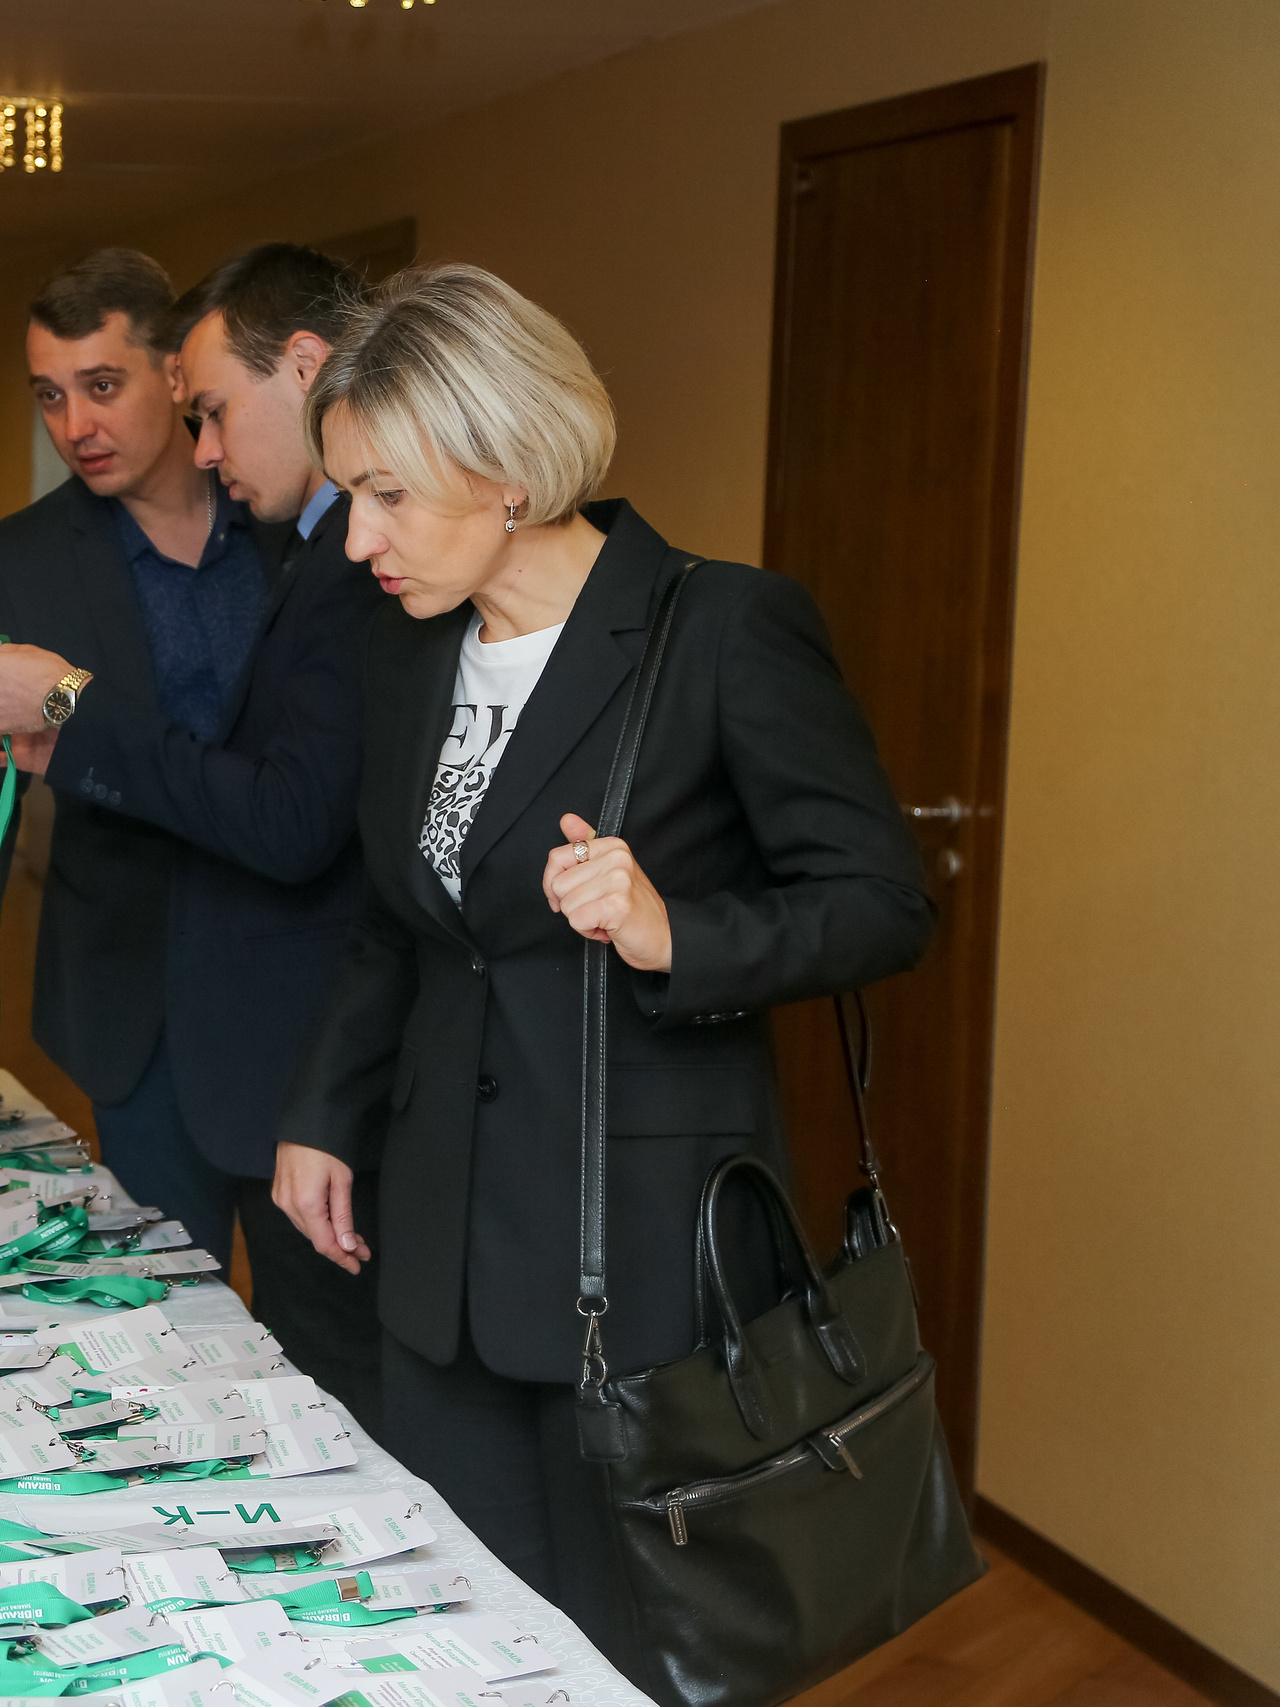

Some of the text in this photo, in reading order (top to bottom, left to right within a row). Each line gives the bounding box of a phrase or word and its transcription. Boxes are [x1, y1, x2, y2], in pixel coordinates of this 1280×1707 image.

[18, 1481, 52, 1490] BRAUN
[387, 1521, 407, 1541] BRAUN
[35, 1609, 43, 1618] B
[212, 1632, 227, 1651] Карпов
[495, 1644, 525, 1663] BRAUN
